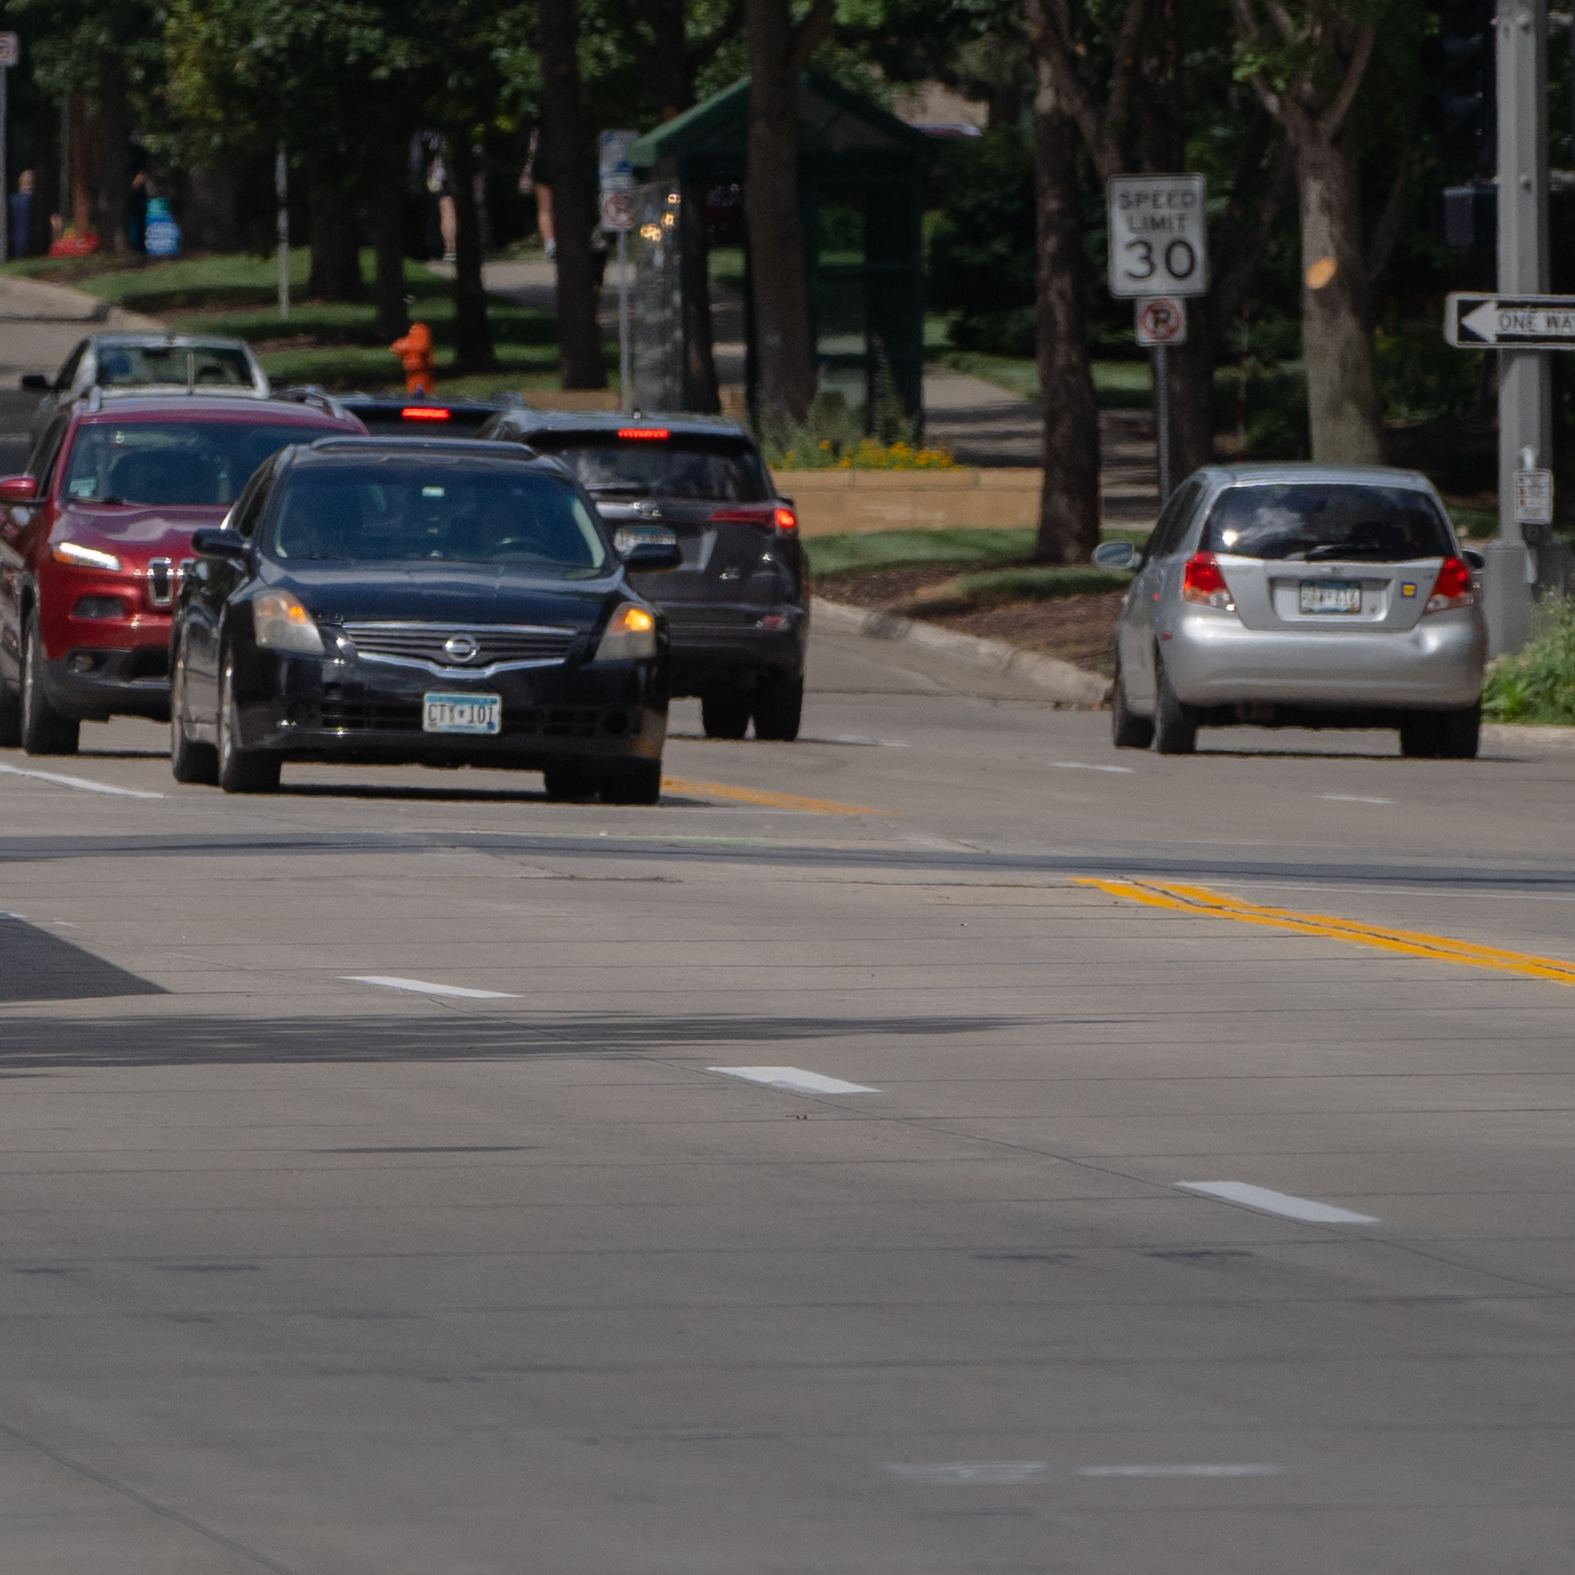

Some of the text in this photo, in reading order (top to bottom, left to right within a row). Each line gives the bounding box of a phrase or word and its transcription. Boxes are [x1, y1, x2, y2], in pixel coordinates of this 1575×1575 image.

[1118, 189, 1197, 211] SPEED
[1127, 212, 1187, 234] LIMIT
[1124, 238, 1197, 281] 30
[1498, 313, 1575, 332] ONE WA
